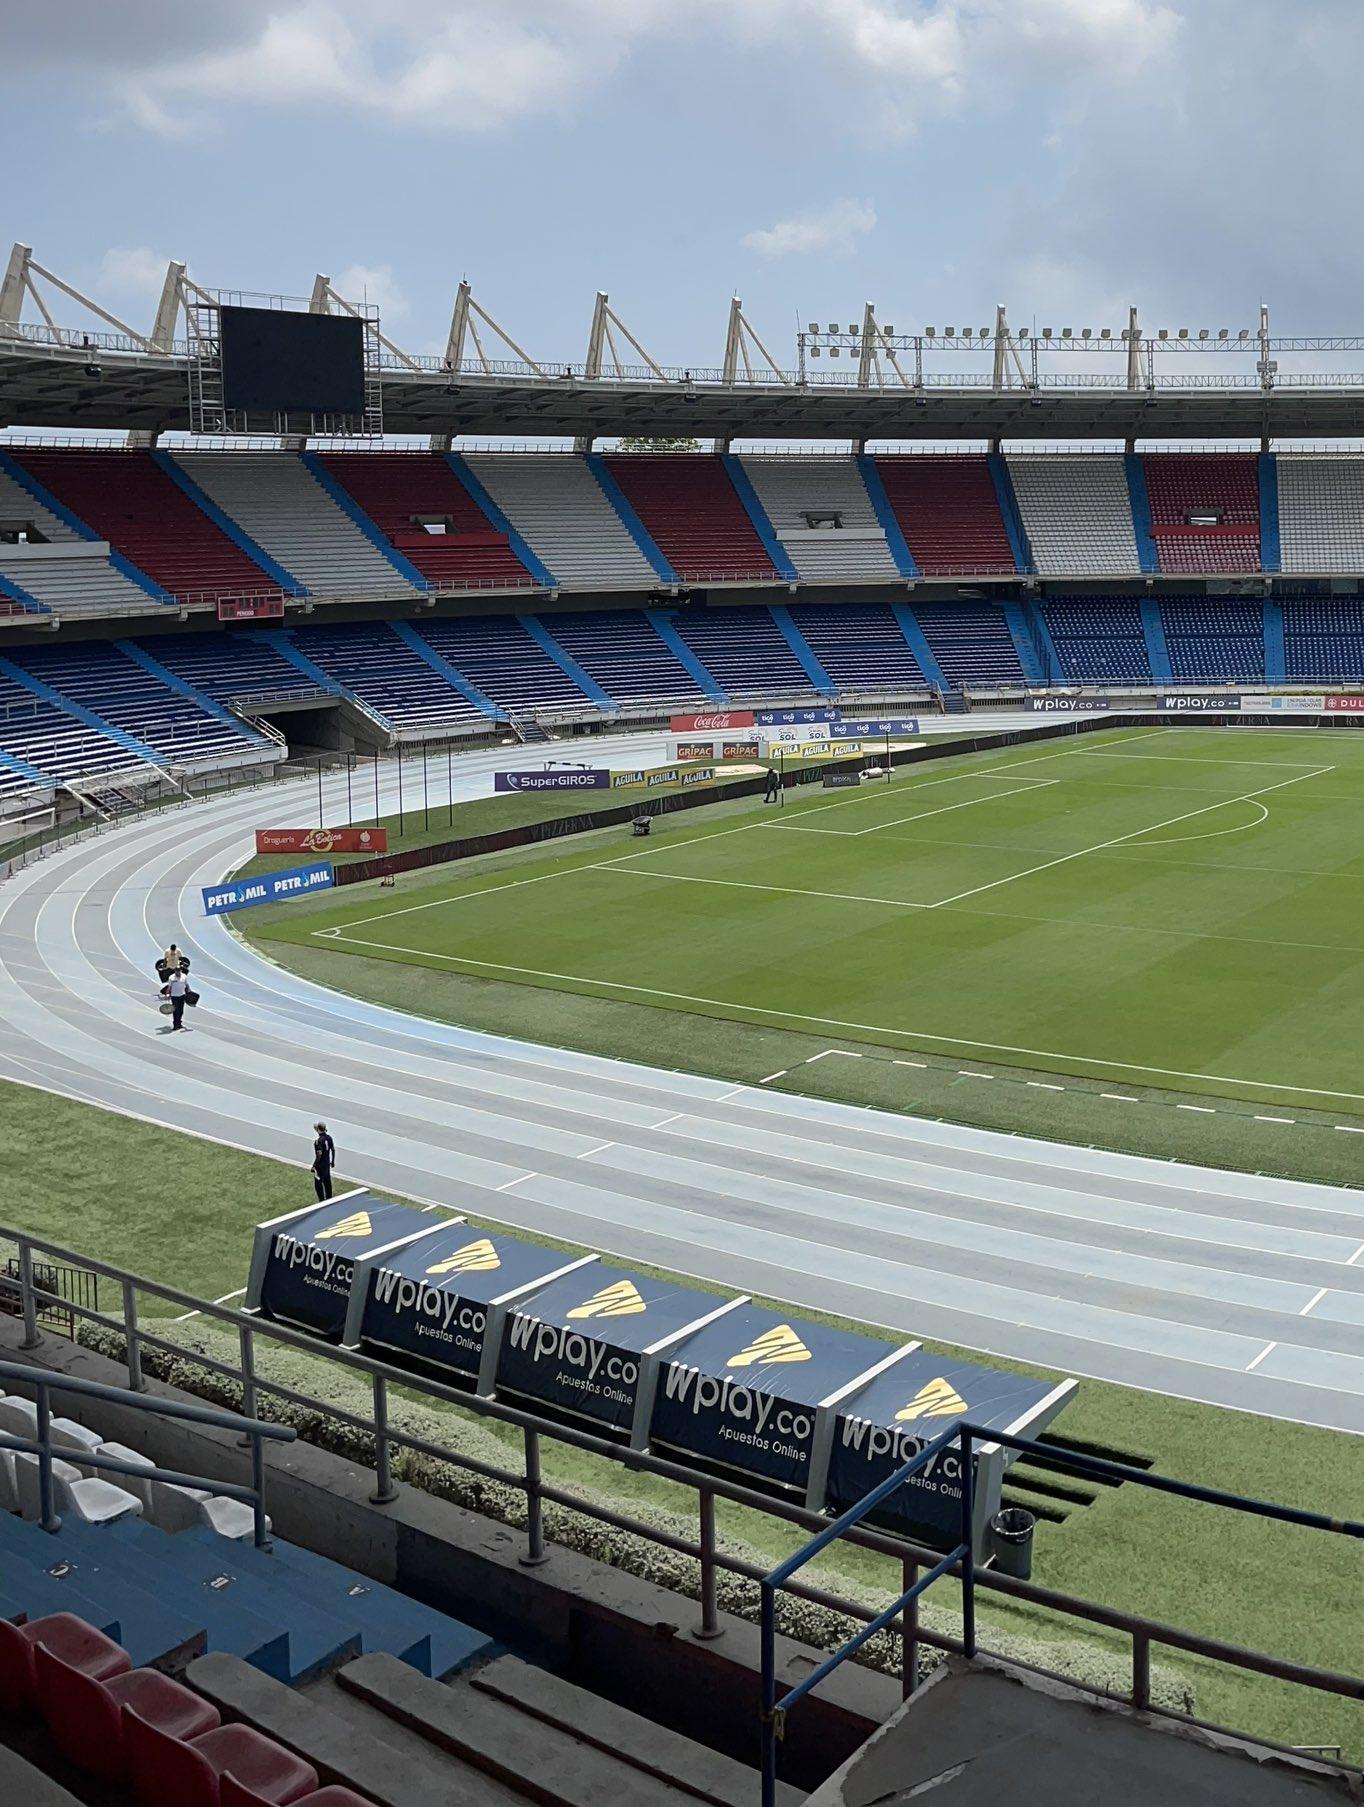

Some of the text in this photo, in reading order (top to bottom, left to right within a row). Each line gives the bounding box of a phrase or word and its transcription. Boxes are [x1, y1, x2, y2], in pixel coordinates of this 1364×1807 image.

[521, 775, 596, 787] SuperGIROS
[414, 1321, 483, 1352] Apuestas Online
[556, 1370, 633, 1405] Apuestas Online
[718, 1424, 807, 1461] Apuestas Online
